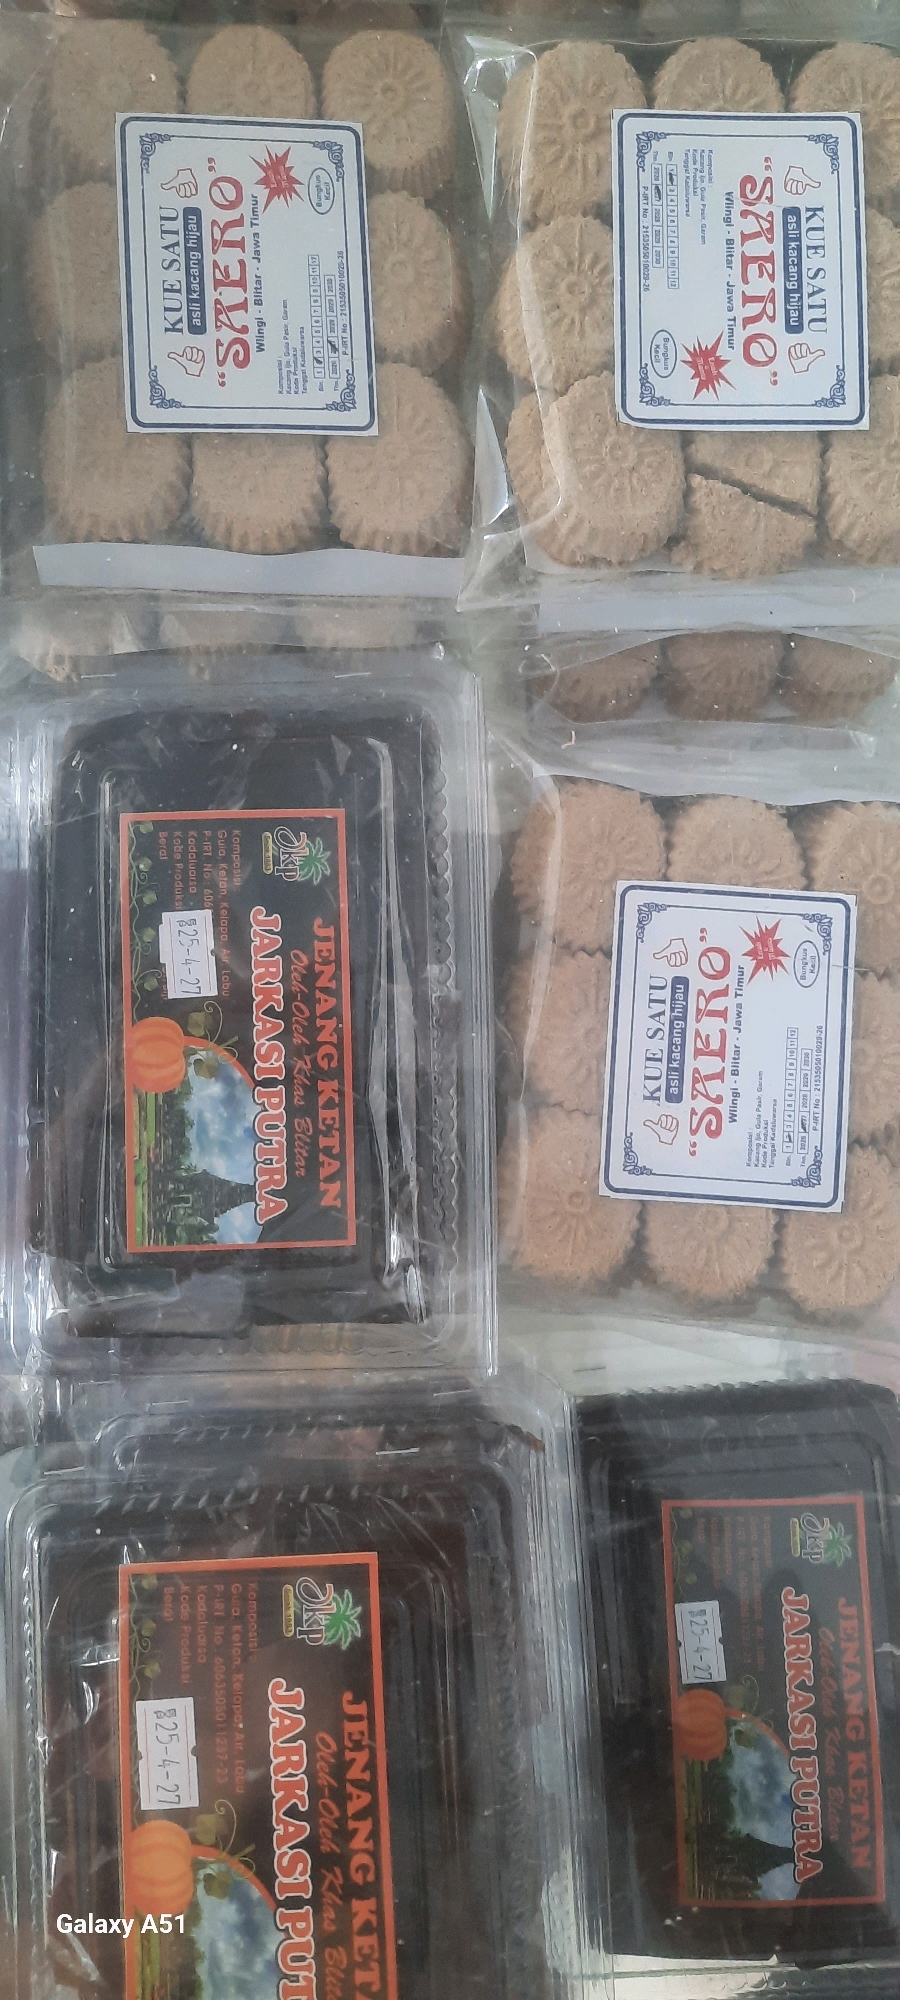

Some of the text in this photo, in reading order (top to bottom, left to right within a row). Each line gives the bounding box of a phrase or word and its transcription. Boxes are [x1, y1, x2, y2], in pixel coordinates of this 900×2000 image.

[250, 194, 259, 228] Timur
[643, 208, 649, 218] No
[159, 205, 183, 335] KUE SATU
[185, 215, 201, 326] asli kacang hijau
[252, 232, 261, 263] Jawa
[725, 238, 736, 270] Blitar
[787, 215, 801, 326] asli kacang hijau
[805, 206, 827, 333] KUE SATU
[253, 275, 263, 306] Blitar
[726, 281, 735, 312] Jawa
[727, 316, 736, 350] Timur
[159, 832, 168, 860] Berat
[173, 831, 183, 859] Kode
[188, 831, 198, 893] Kadaluarsa
[203, 864, 212, 879] No
[232, 830, 242, 886] Komposisi
[222, 971, 230, 997] Labu
[735, 965, 744, 999] Timur
[800, 948, 808, 980] Bungkus
[643, 975, 667, 1102] KUE SATU
[669, 984, 684, 1094] asli kacang hijau
[733, 1002, 742, 1033] Jawa
[250, 906, 288, 1225] JARKASI PUTRA
[290, 949, 313, 1177] Oleh-Oleh Khas Blitar
[313, 918, 341, 1208] JENANG KETAN
[731, 1044, 741, 1076] Blitar
[813, 1099, 820, 1108] No
[180, 1587, 191, 1684] Kode Produksi
[198, 1586, 207, 1663] Kadaluarsa
[780, 1587, 823, 1883] JARKASI PUTRA
[837, 1598, 871, 1868] JENANG KETAN
[268, 1678, 313, 1900] JARKASI
[316, 1732, 341, 1854] Oleh-Oleh
[341, 1691, 374, 1886] JENANG
[320, 1867, 342, 1932] Khas
